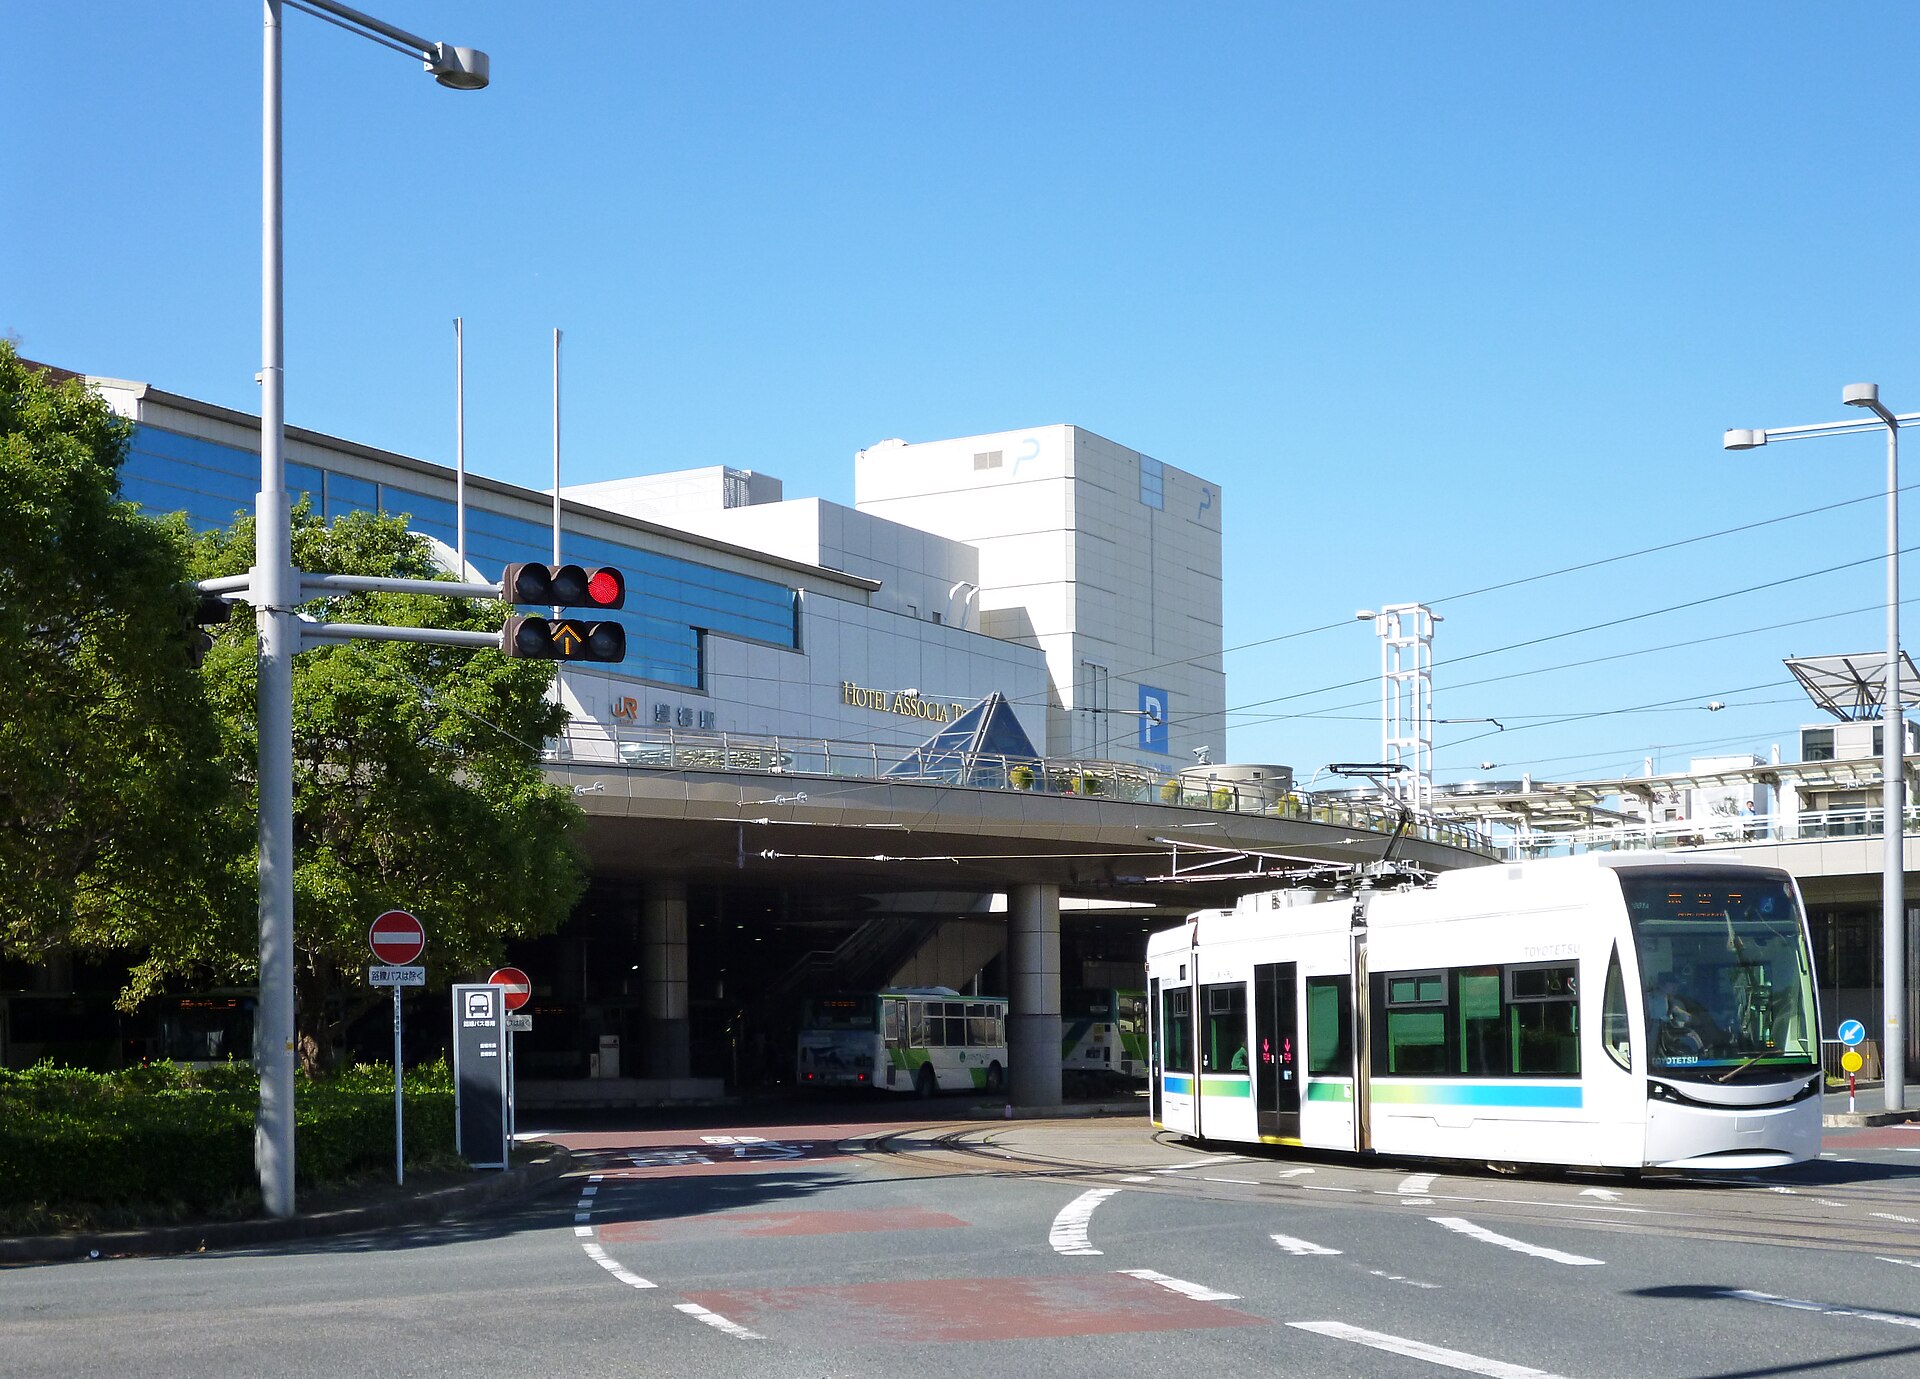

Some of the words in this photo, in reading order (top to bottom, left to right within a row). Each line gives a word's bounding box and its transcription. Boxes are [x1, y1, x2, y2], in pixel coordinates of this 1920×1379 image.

[611, 696, 638, 720] JR
[842, 681, 890, 711] HOTEL
[892, 692, 949, 722] ASSOCIA
[1145, 695, 1162, 744] P
[1524, 943, 1581, 958] TOYOTETSU
[372, 970, 423, 981] 路線バスは除く
